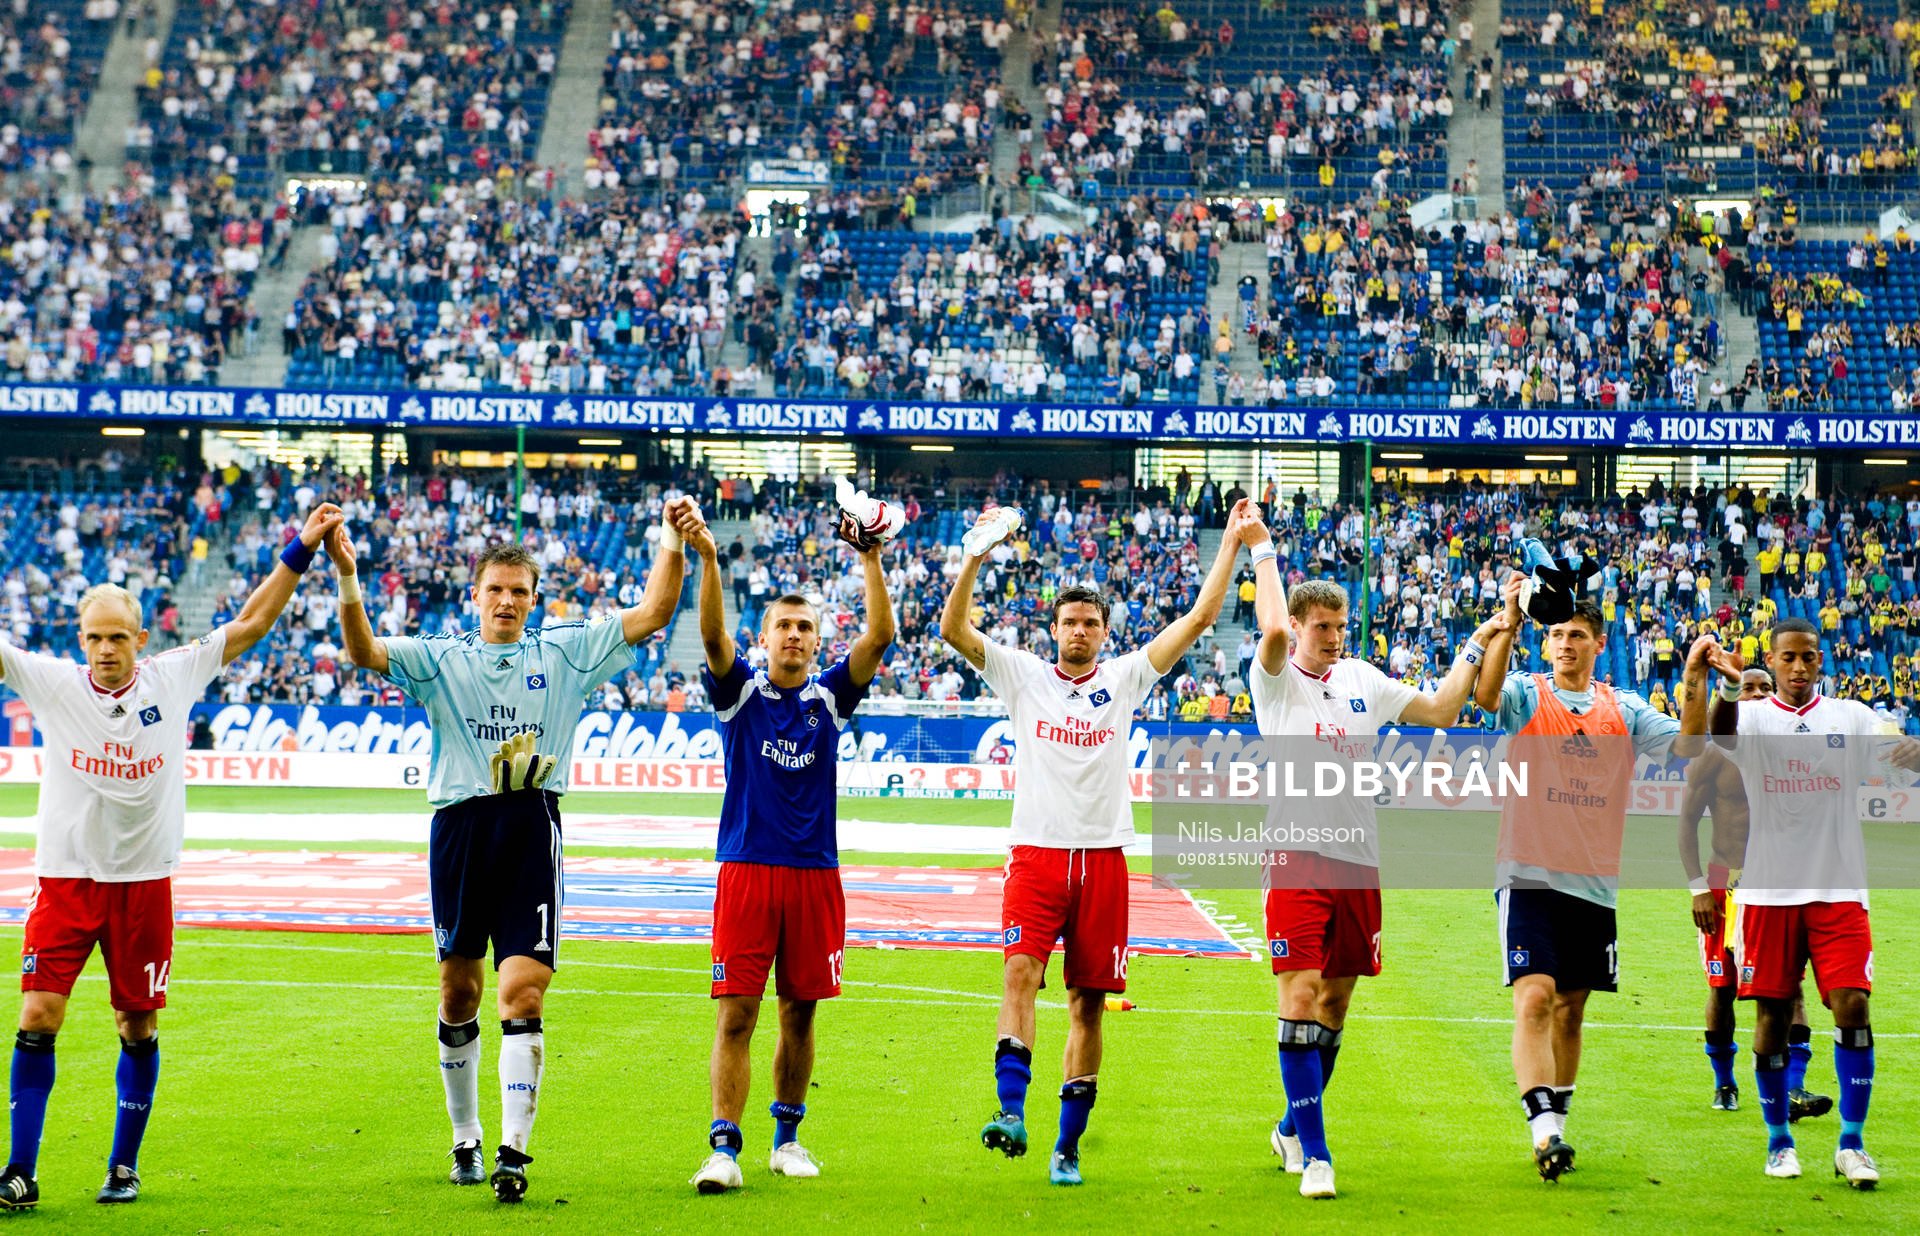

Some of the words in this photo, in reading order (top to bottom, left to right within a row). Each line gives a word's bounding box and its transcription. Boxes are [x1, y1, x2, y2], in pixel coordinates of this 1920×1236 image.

[121, 390, 236, 415] HOLSTEN
[276, 394, 390, 418] HOLSTEN
[430, 397, 544, 421] HOLSTEN
[583, 401, 698, 424] HOLSTEN
[737, 404, 848, 427] HOLSTEN
[889, 407, 1001, 430] HOLSTEN
[1042, 409, 1153, 432] HOLSTEN
[1194, 412, 1307, 434] HOLSTEN
[1349, 414, 1462, 437] HOLSTEN
[1503, 416, 1616, 439] HOLSTEN
[1660, 418, 1774, 440] HOLSTEN
[490, 704, 516, 721] Fly
[1036, 720, 1115, 747] Emirates
[104, 742, 134, 760] Fly
[761, 740, 816, 769] Emirates
[777, 739, 798, 754] Fly
[71, 748, 164, 780] Emirates
[1788, 759, 1811, 775] Fly
[1570, 778, 1588, 792] Fly
[1763, 774, 1841, 794] Emirates
[1547, 787, 1607, 808] Emirates
[536, 904, 548, 939] 1
[1112, 945, 1128, 980] 16
[144, 960, 169, 998] 14
[507, 1083, 536, 1092] HSV
[119, 1100, 148, 1111] HSV
[1291, 1096, 1319, 1109] HSV
